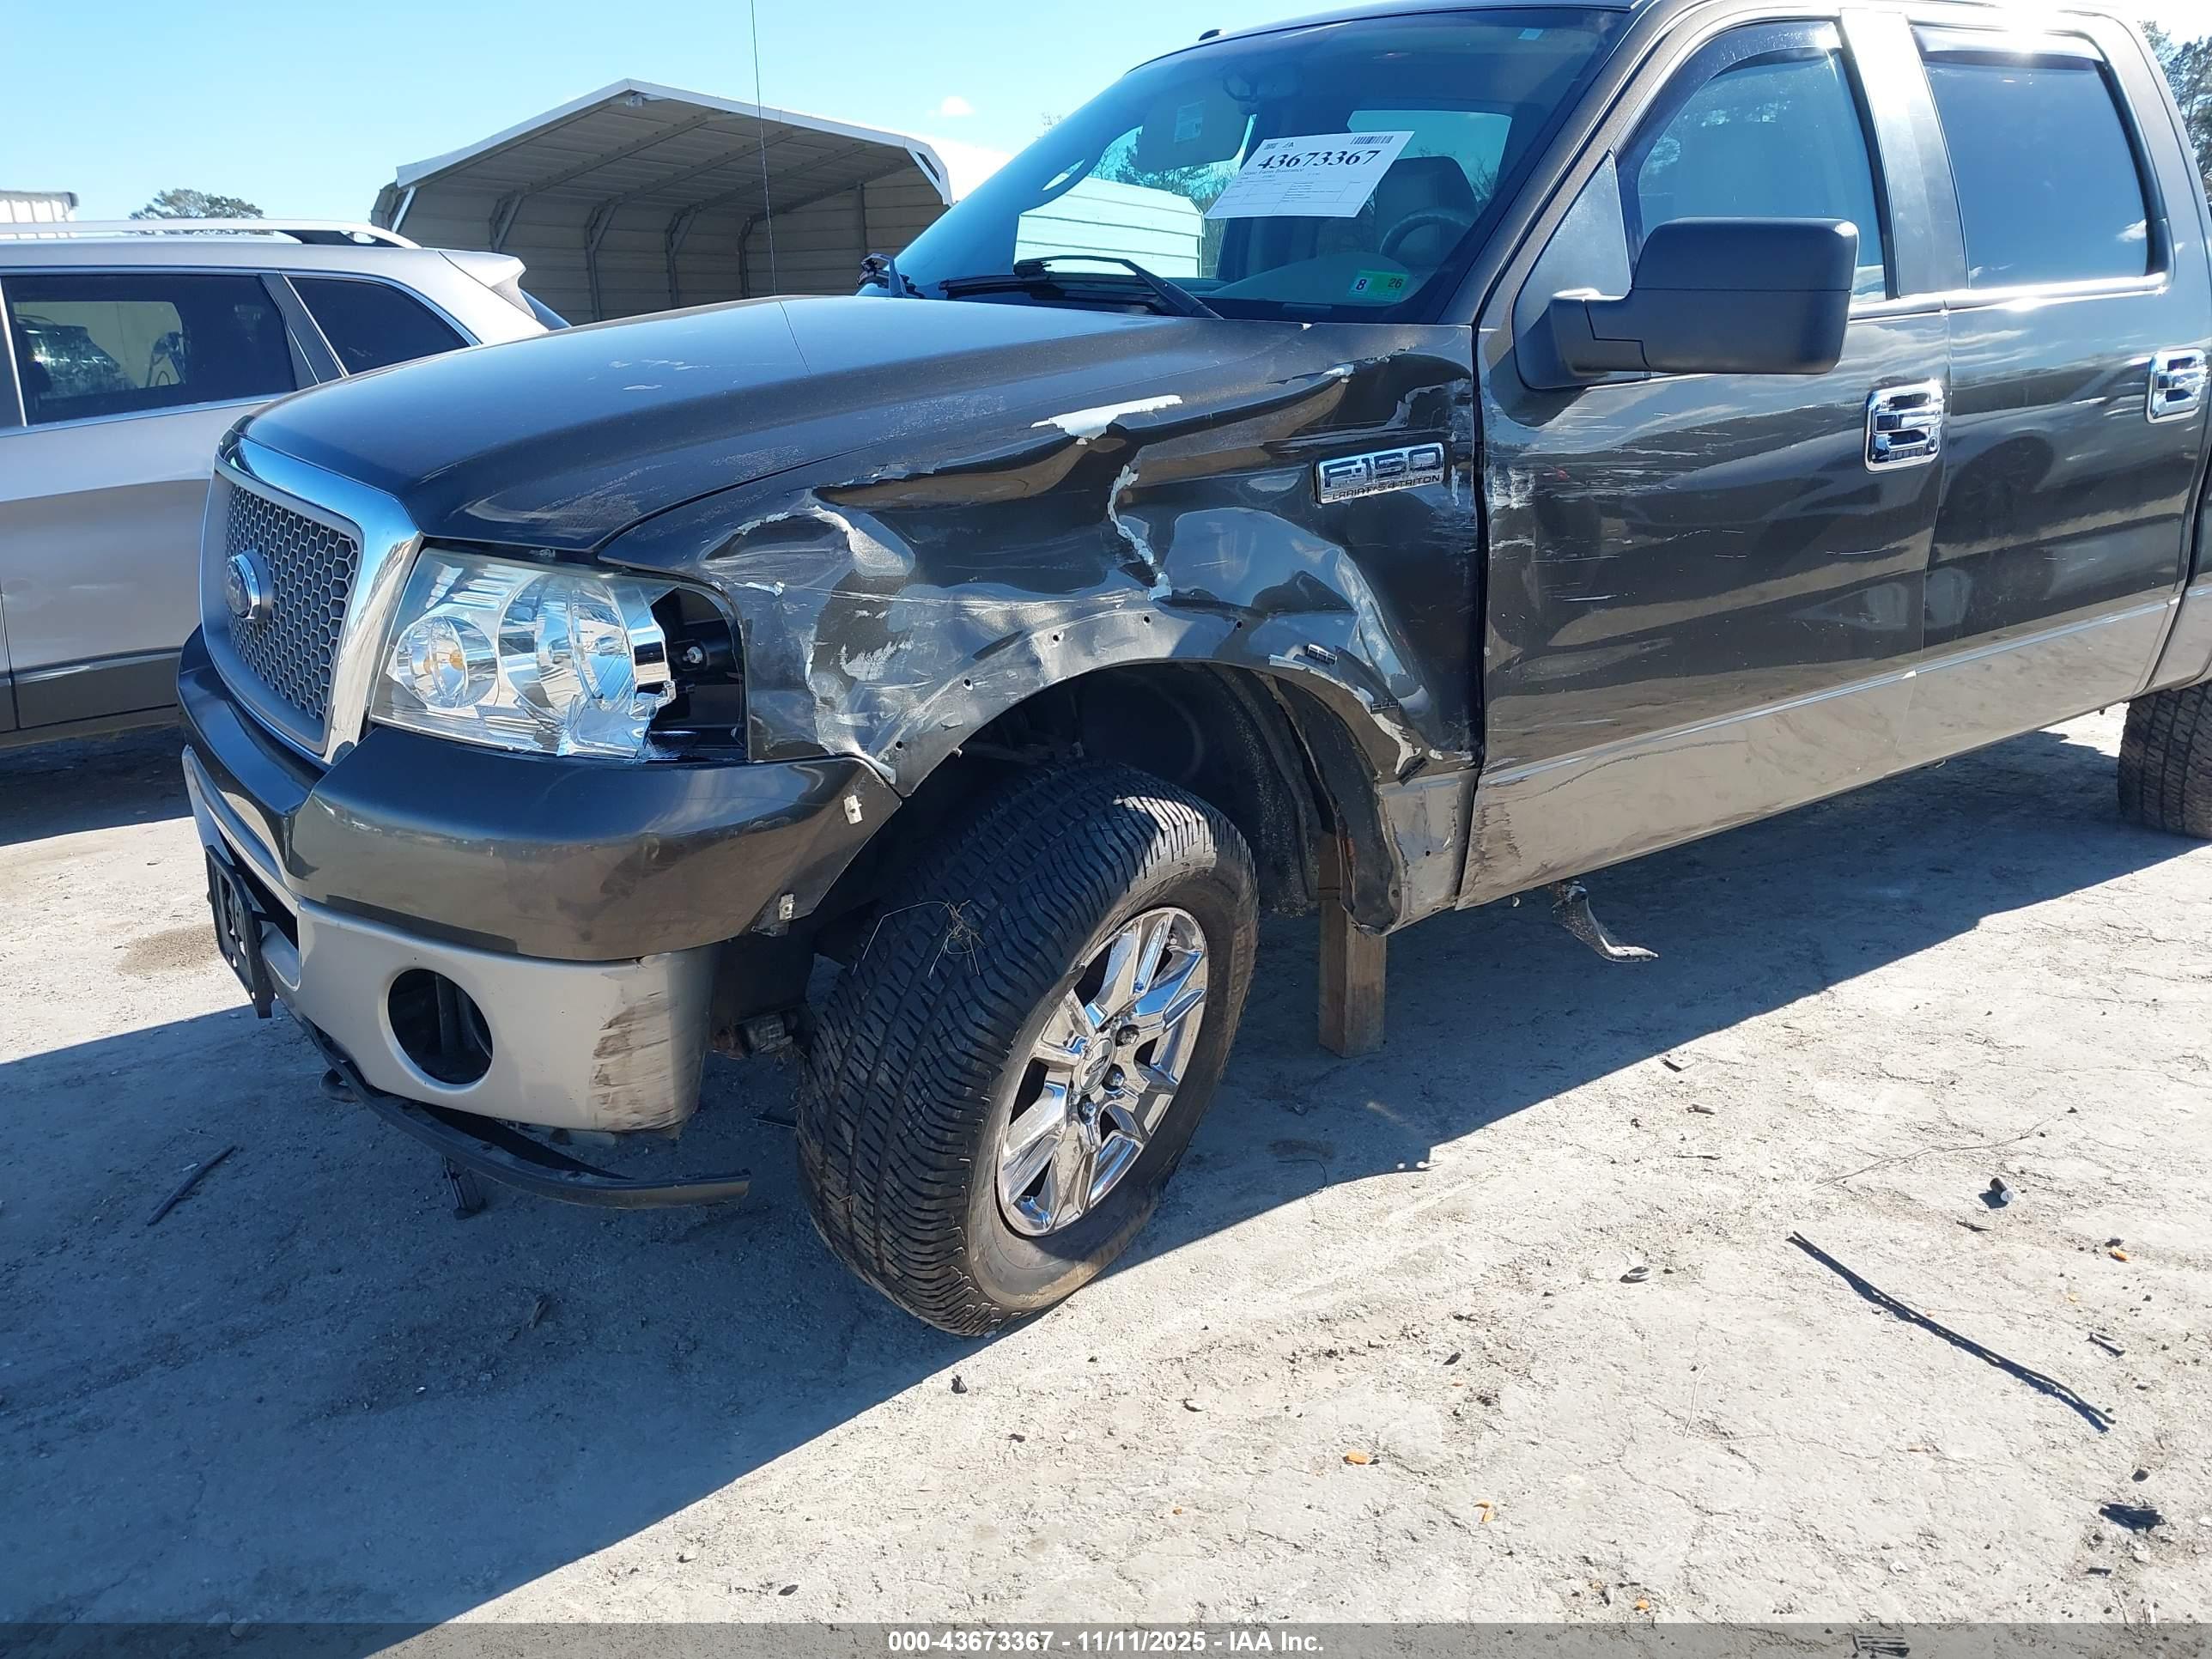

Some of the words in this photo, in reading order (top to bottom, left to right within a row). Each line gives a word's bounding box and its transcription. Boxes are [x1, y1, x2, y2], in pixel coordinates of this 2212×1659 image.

[1257, 149, 1381, 169] 43673367
[1356, 278, 1367, 290] 8
[1388, 277, 1403, 289] 26
[1399, 474, 1439, 488] TRITON
